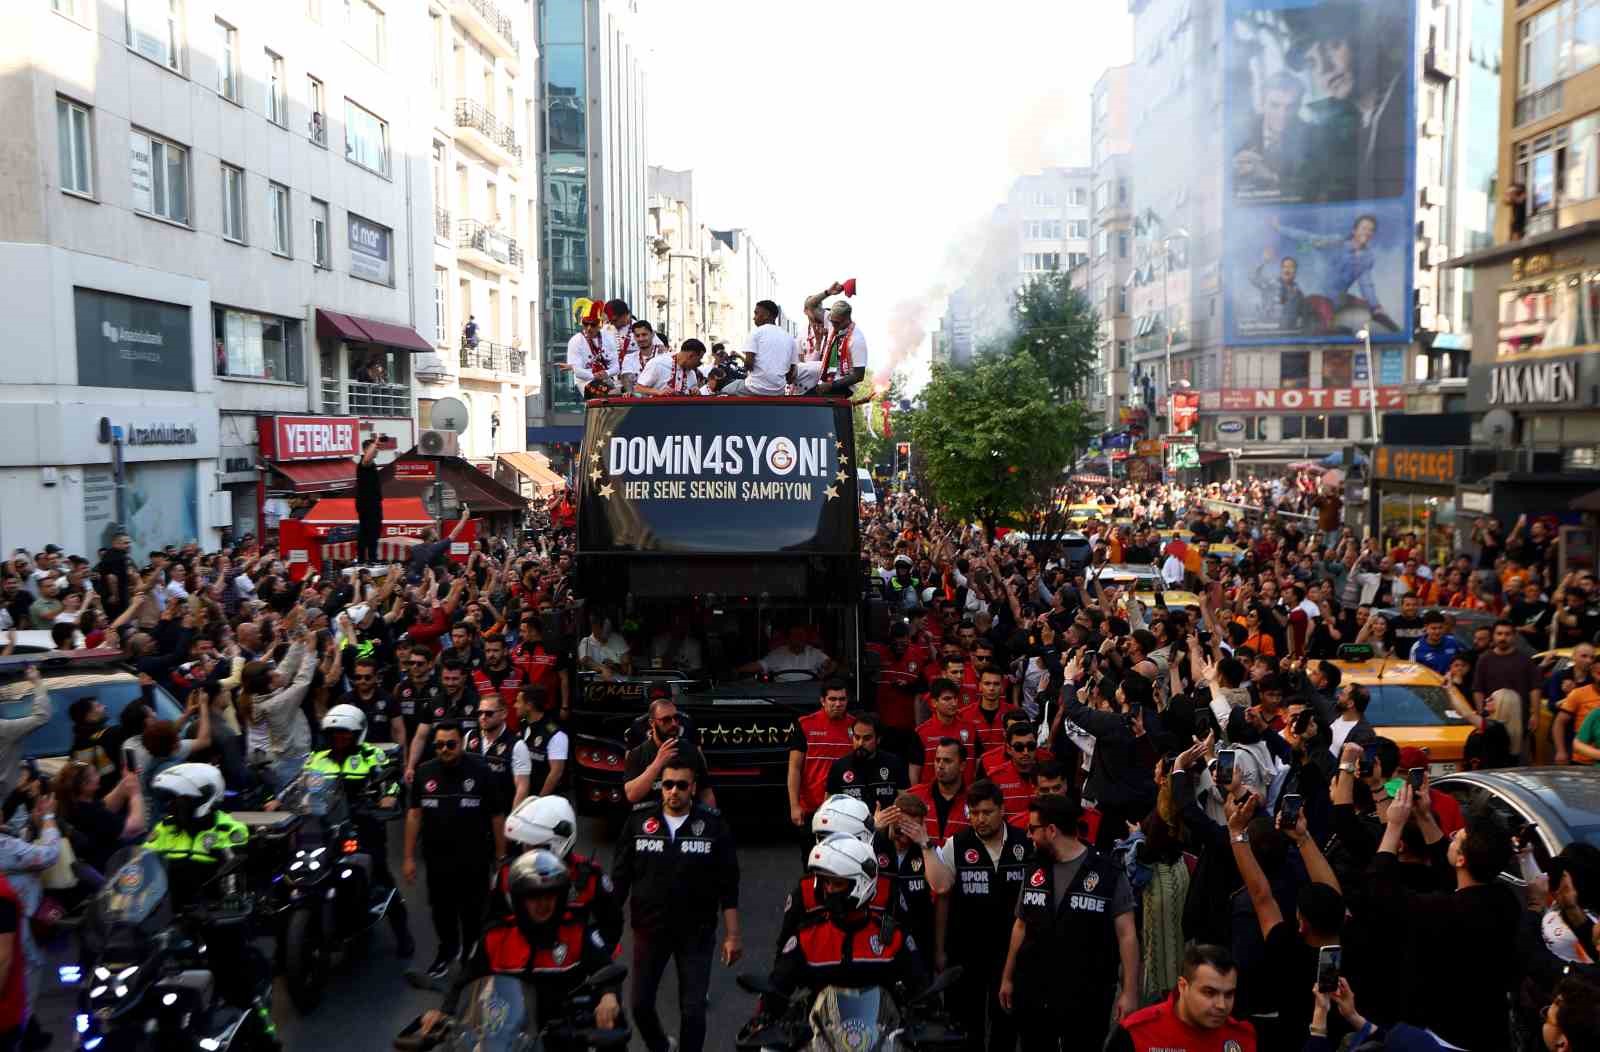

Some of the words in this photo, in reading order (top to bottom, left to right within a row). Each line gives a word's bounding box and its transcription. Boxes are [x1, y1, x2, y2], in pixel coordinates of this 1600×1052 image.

[285, 424, 353, 453] YETERLER
[625, 481, 650, 500] HER
[653, 481, 686, 499] SENE
[635, 838, 664, 852] SPOR
